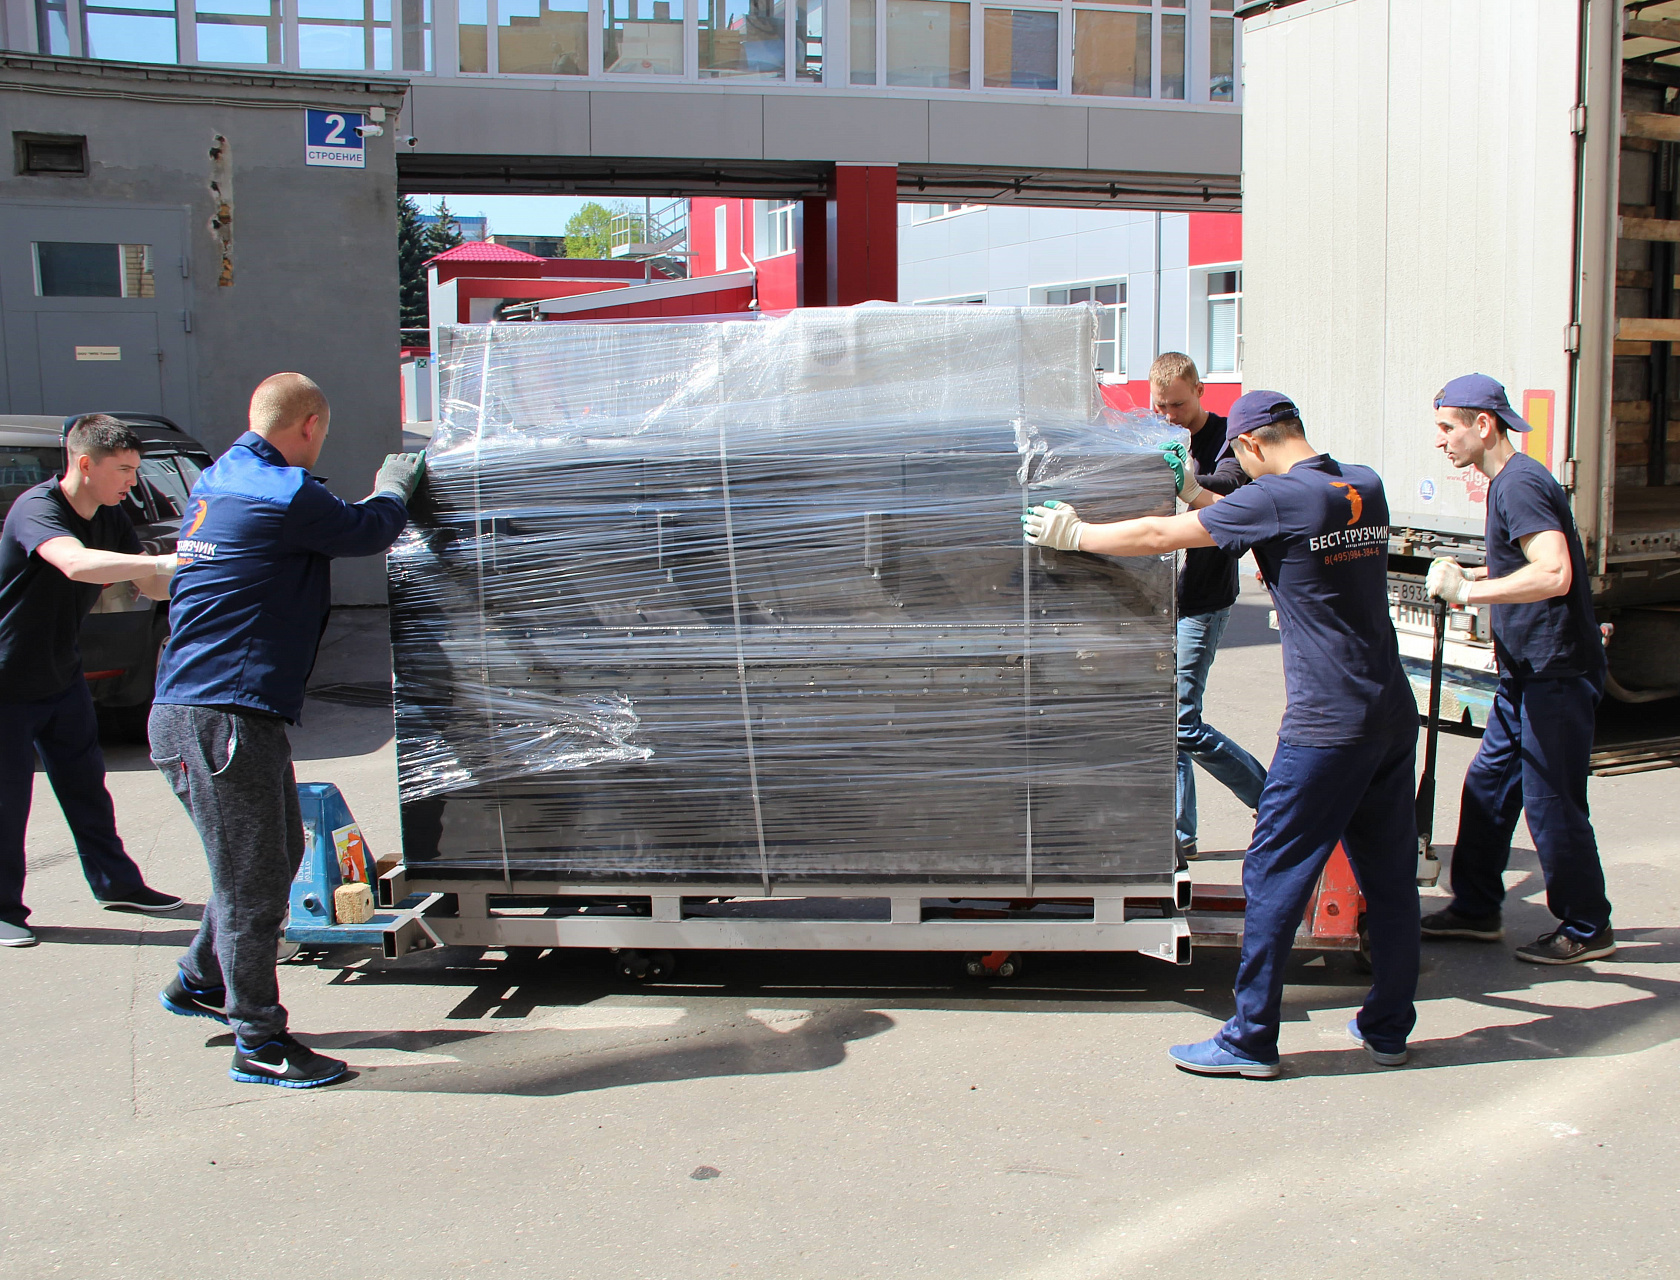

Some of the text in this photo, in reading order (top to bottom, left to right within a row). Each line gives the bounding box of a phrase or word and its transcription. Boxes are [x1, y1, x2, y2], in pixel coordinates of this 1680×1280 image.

[325, 113, 346, 145] 2
[308, 151, 363, 162] СТРОЕНИЕ
[1309, 525, 1389, 552] БЕСТ-ГРУЗЧИК
